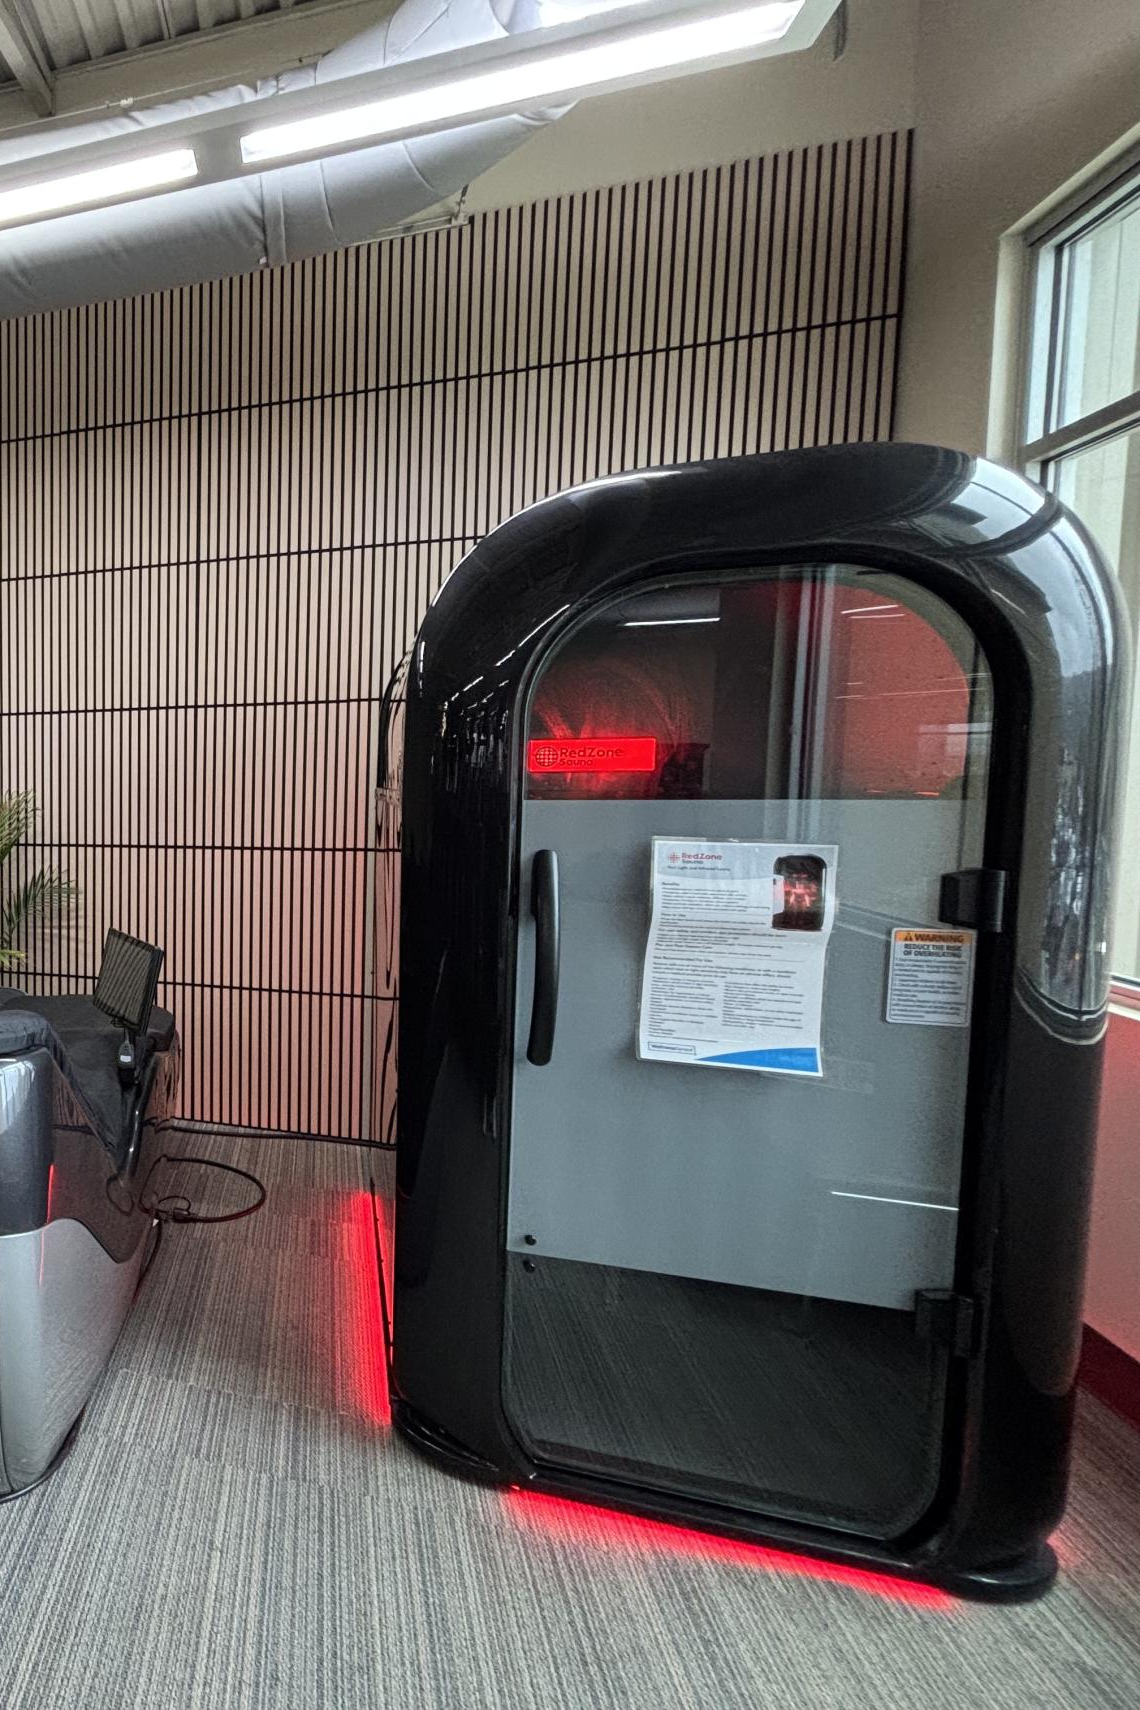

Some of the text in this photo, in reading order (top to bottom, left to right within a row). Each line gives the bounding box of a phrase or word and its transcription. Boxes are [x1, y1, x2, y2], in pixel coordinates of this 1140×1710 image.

[559, 747, 625, 758] RedZone
[559, 758, 594, 767] Sauna
[681, 852, 723, 861] RedZone
[914, 932, 964, 943] WARNING
[904, 943, 931, 951] REDUCE
